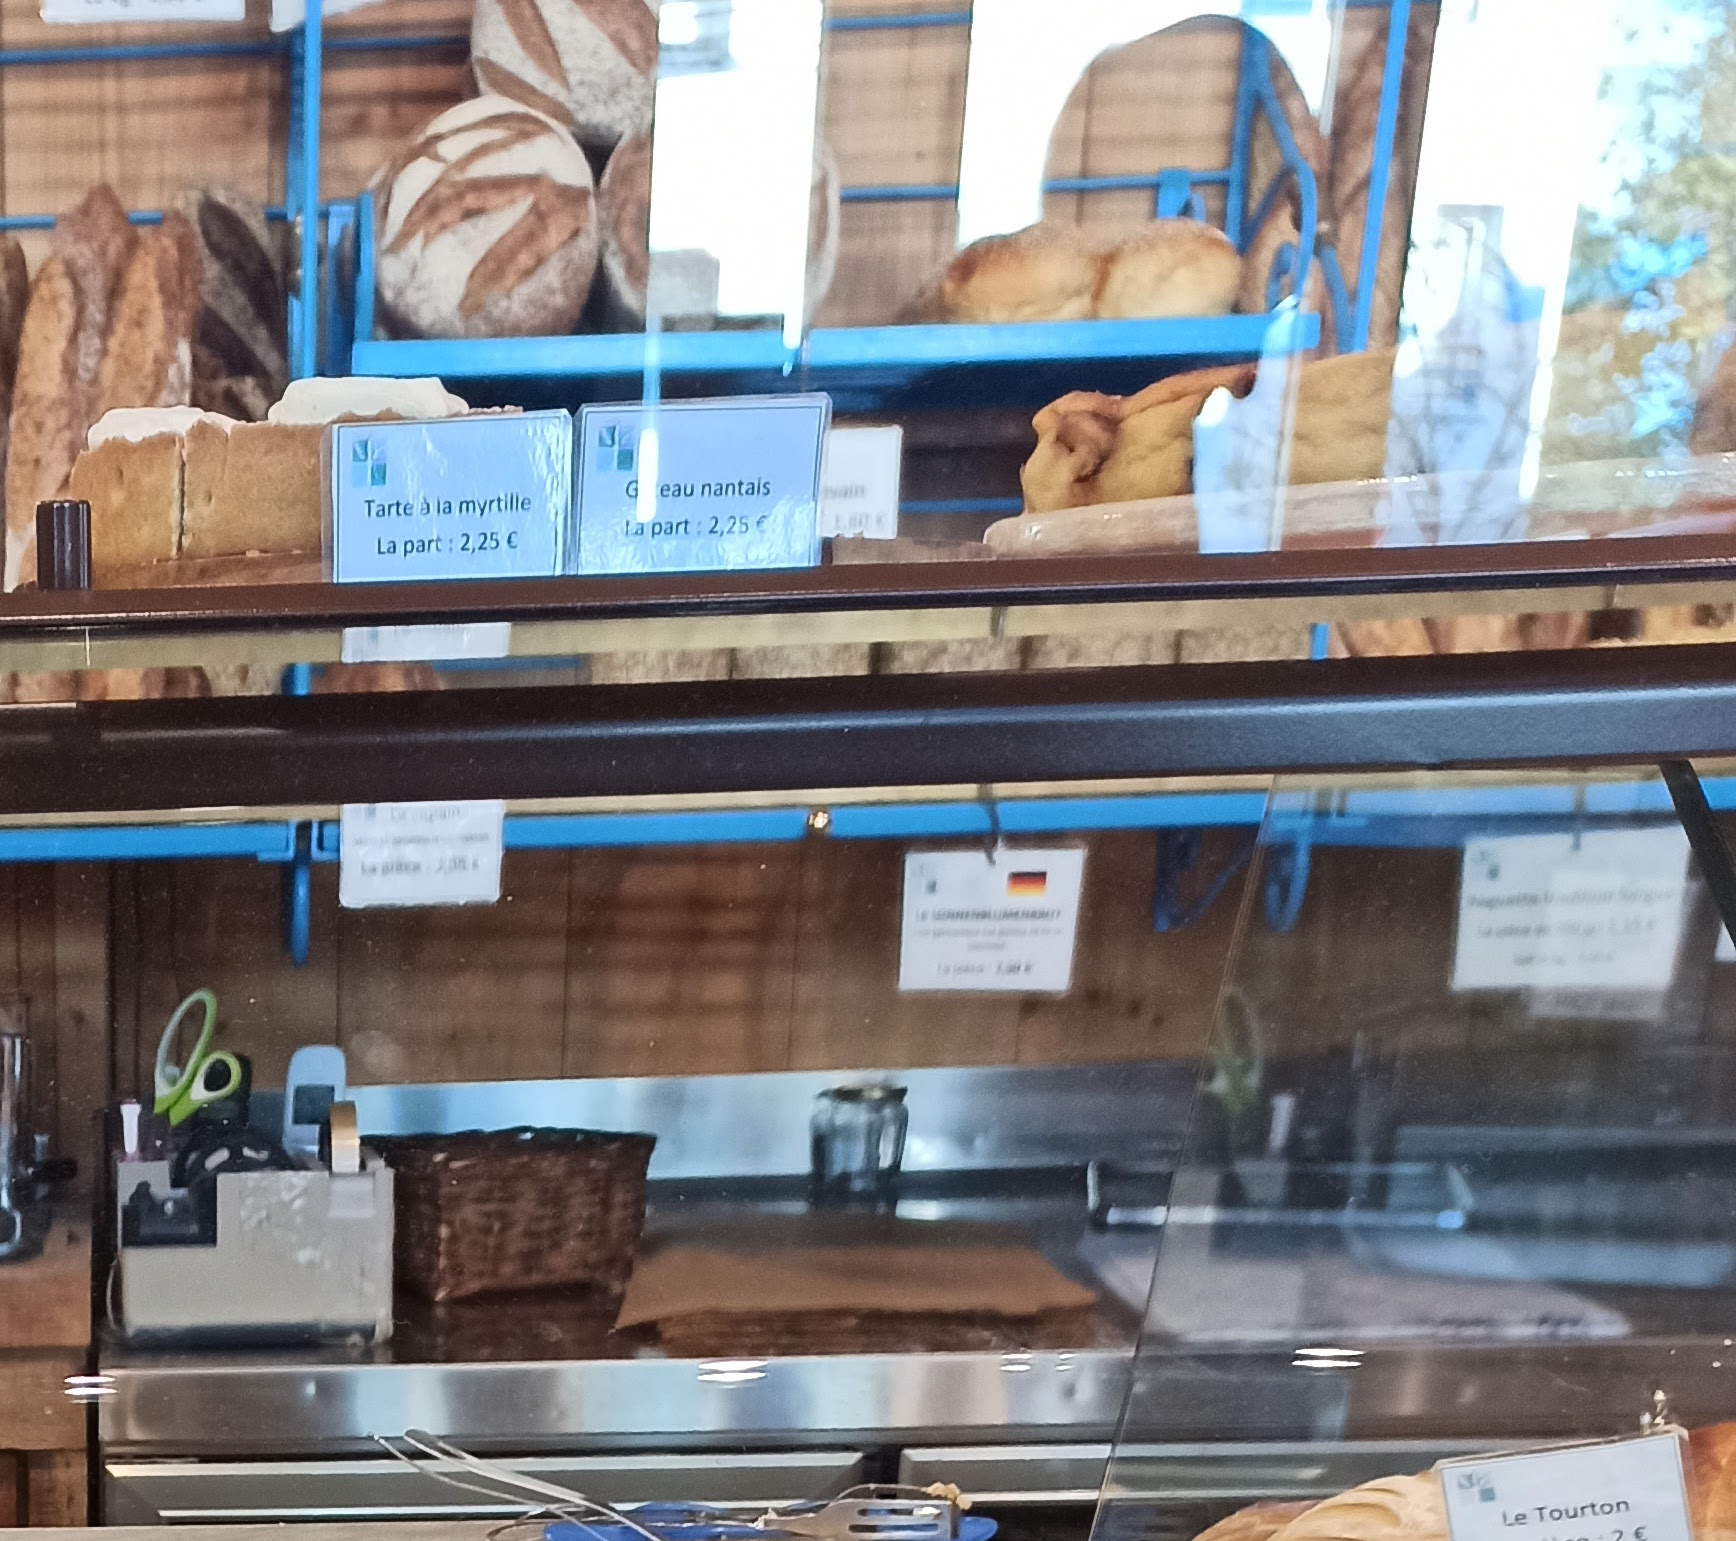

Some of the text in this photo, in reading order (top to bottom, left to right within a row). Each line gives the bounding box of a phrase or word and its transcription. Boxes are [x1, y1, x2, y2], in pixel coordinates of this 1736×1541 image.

[625, 477, 771, 498] Geau nantais
[365, 491, 532, 518] Tarte à la myrtille
[651, 518, 690, 538] part
[708, 515, 749, 537] 2,25
[756, 514, 768, 534] €
[377, 536, 396, 555] La
[403, 535, 442, 558] part
[460, 532, 500, 555] 2,25
[507, 531, 518, 550] €
[1502, 1498, 1630, 1526] Le Tourton
